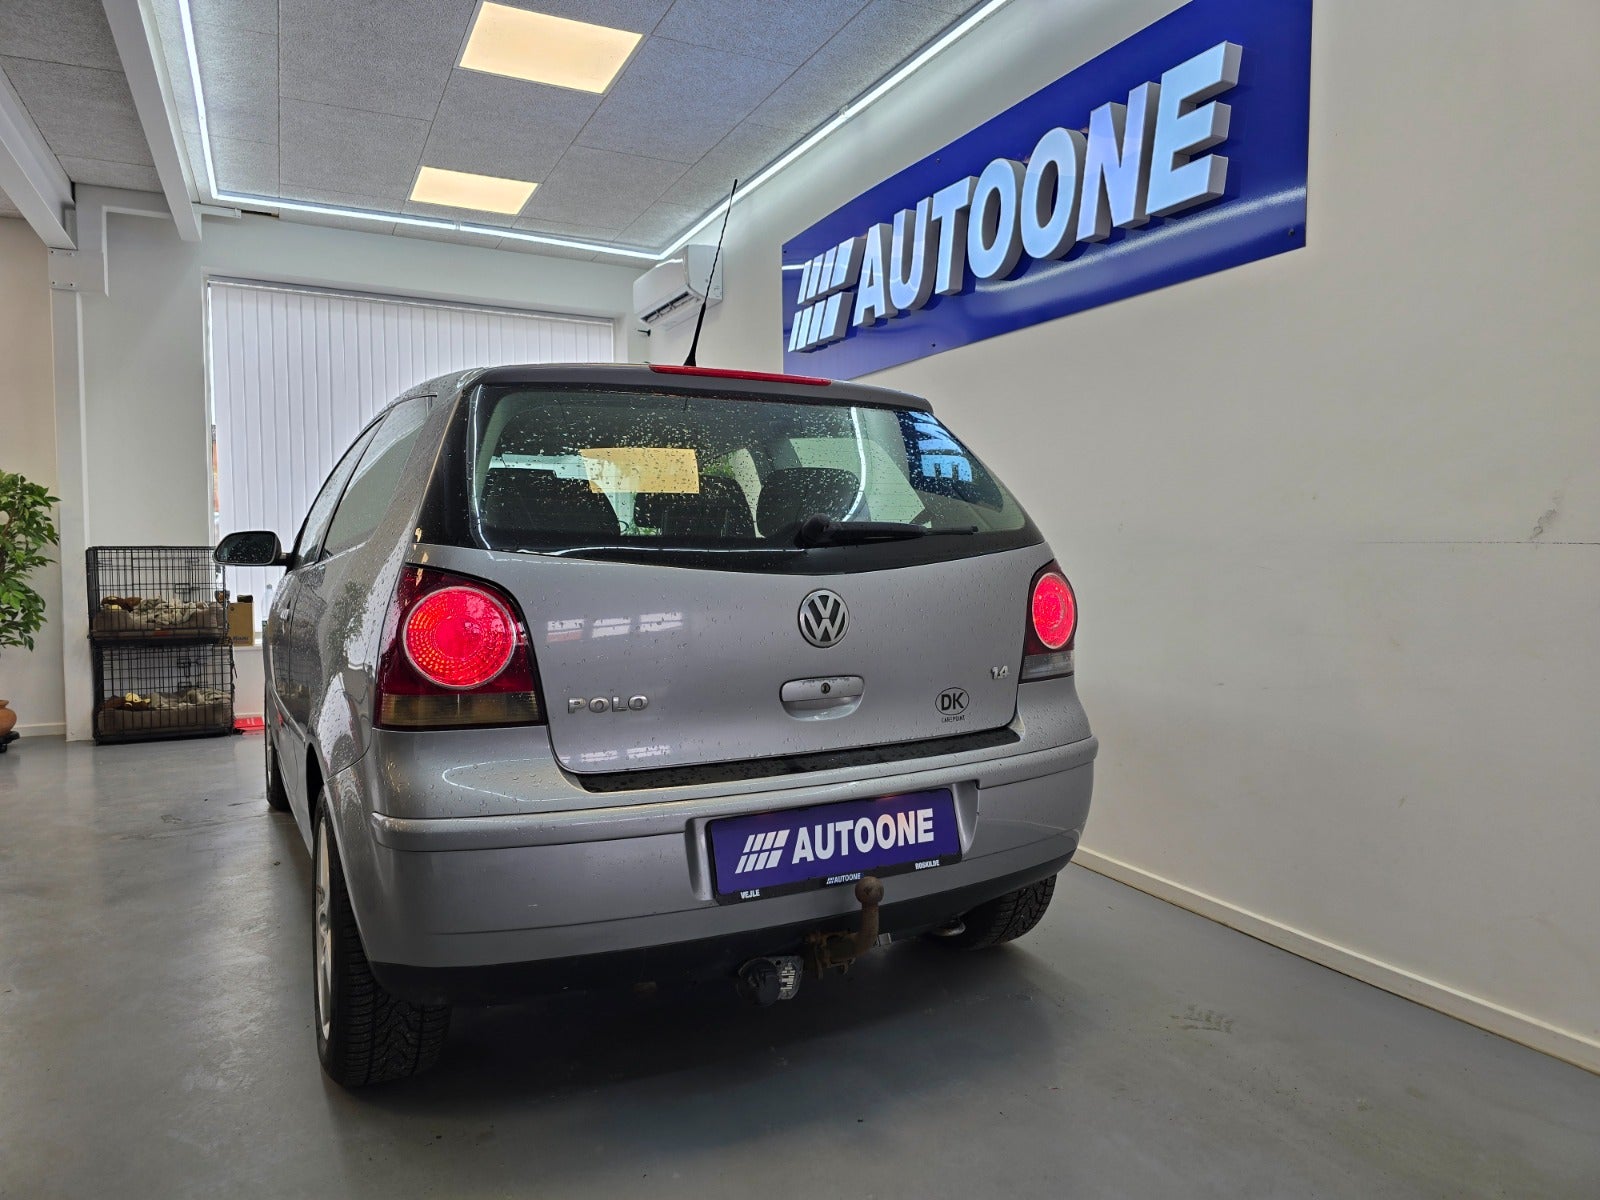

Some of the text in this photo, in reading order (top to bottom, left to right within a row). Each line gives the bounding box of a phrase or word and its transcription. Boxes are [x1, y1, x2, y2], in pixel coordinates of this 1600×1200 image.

[853, 40, 1241, 327] AUTOONE
[568, 695, 648, 714] POLO
[941, 692, 965, 711] DK
[791, 808, 935, 864] AUTOONE
[834, 872, 861, 883] AUTOONE
[740, 889, 760, 899] VEJLE
